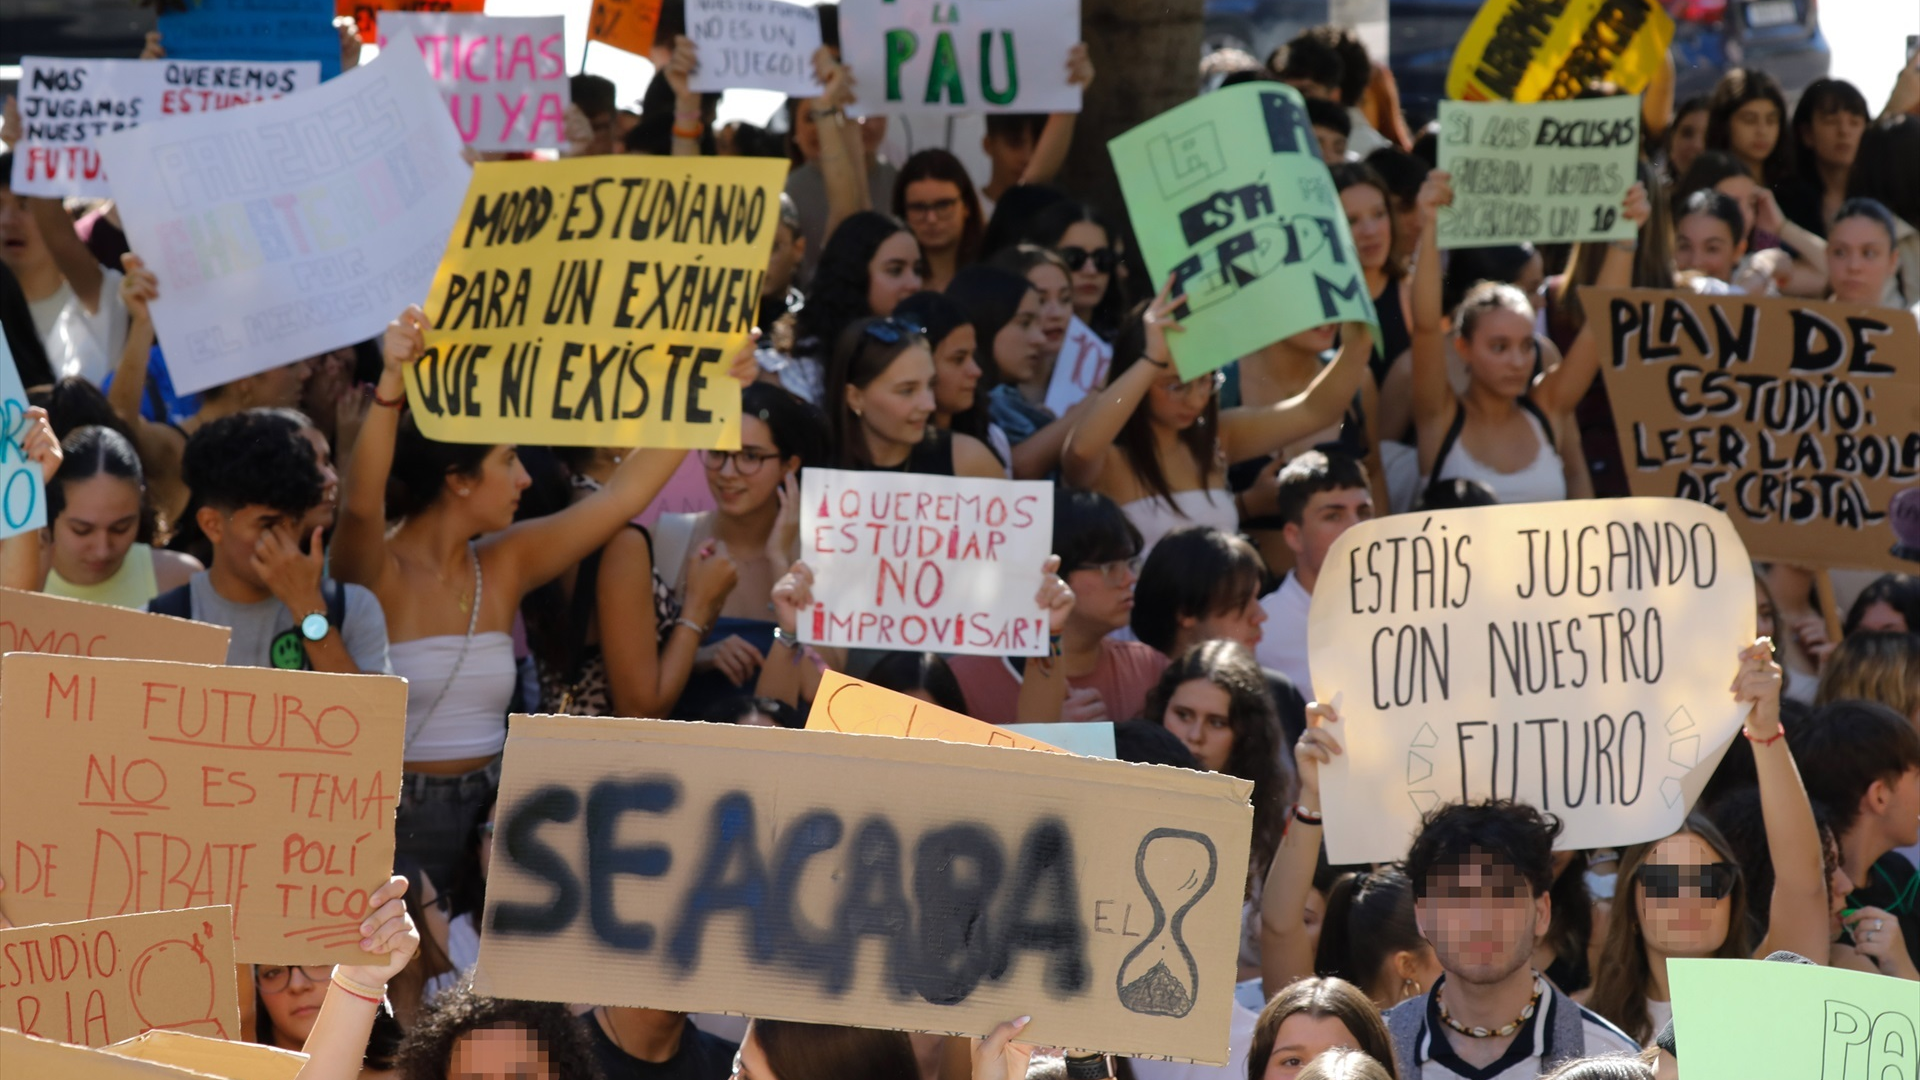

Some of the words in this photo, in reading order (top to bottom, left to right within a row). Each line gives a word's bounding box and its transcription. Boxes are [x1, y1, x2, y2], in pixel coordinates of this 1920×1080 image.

[694, 15, 723, 40] NO
[729, 20, 754, 40] ES
[760, 24, 796, 47] UN
[931, 3, 960, 24] LA
[32, 67, 88, 91] NOS
[165, 63, 296, 92] QUEREMOS
[885, 29, 1019, 105] PAU
[26, 97, 141, 118] JUGAMOS
[1535, 116, 1636, 148] EXCUSAS
[1146, 120, 1227, 201] LA
[1178, 169, 1276, 250] ESTÁ
[1589, 203, 1618, 233] 10
[434, 267, 532, 331] PARA
[543, 258, 603, 326] UN
[614, 254, 765, 334] EXÁMEN
[1610, 297, 1762, 369] PLAN
[1788, 307, 1896, 377] DE
[413, 344, 493, 419] QUE
[500, 336, 543, 419] NI
[551, 340, 725, 424] EXISTE.
[1667, 364, 1877, 434] ESTUDIO:
[1633, 421, 1749, 472] LEER
[1758, 430, 1827, 473] LA
[1675, 471, 1733, 512] DE
[1735, 471, 1886, 530] CRISTAL
[815, 522, 1006, 561] ESTUDIAR
[1349, 517, 1472, 615] ESTÁIS
[1516, 521, 1717, 599] JUGANDO
[876, 558, 944, 609] NO
[1371, 622, 1450, 711] CON
[1488, 606, 1664, 698] NUESTRO
[46, 672, 96, 722] MI
[142, 682, 360, 748] FUTURO
[84, 754, 167, 803] NO
[202, 765, 256, 807] ES
[278, 771, 395, 830] TEMA
[1456, 710, 1647, 812] FUTURO
[15, 840, 58, 898] DE
[87, 828, 257, 940] DEBATE
[282, 832, 372, 877] POLÍ
[276, 883, 368, 919] TICO
[1093, 898, 1140, 938] EL
[1820, 999, 1920, 1080] PA
